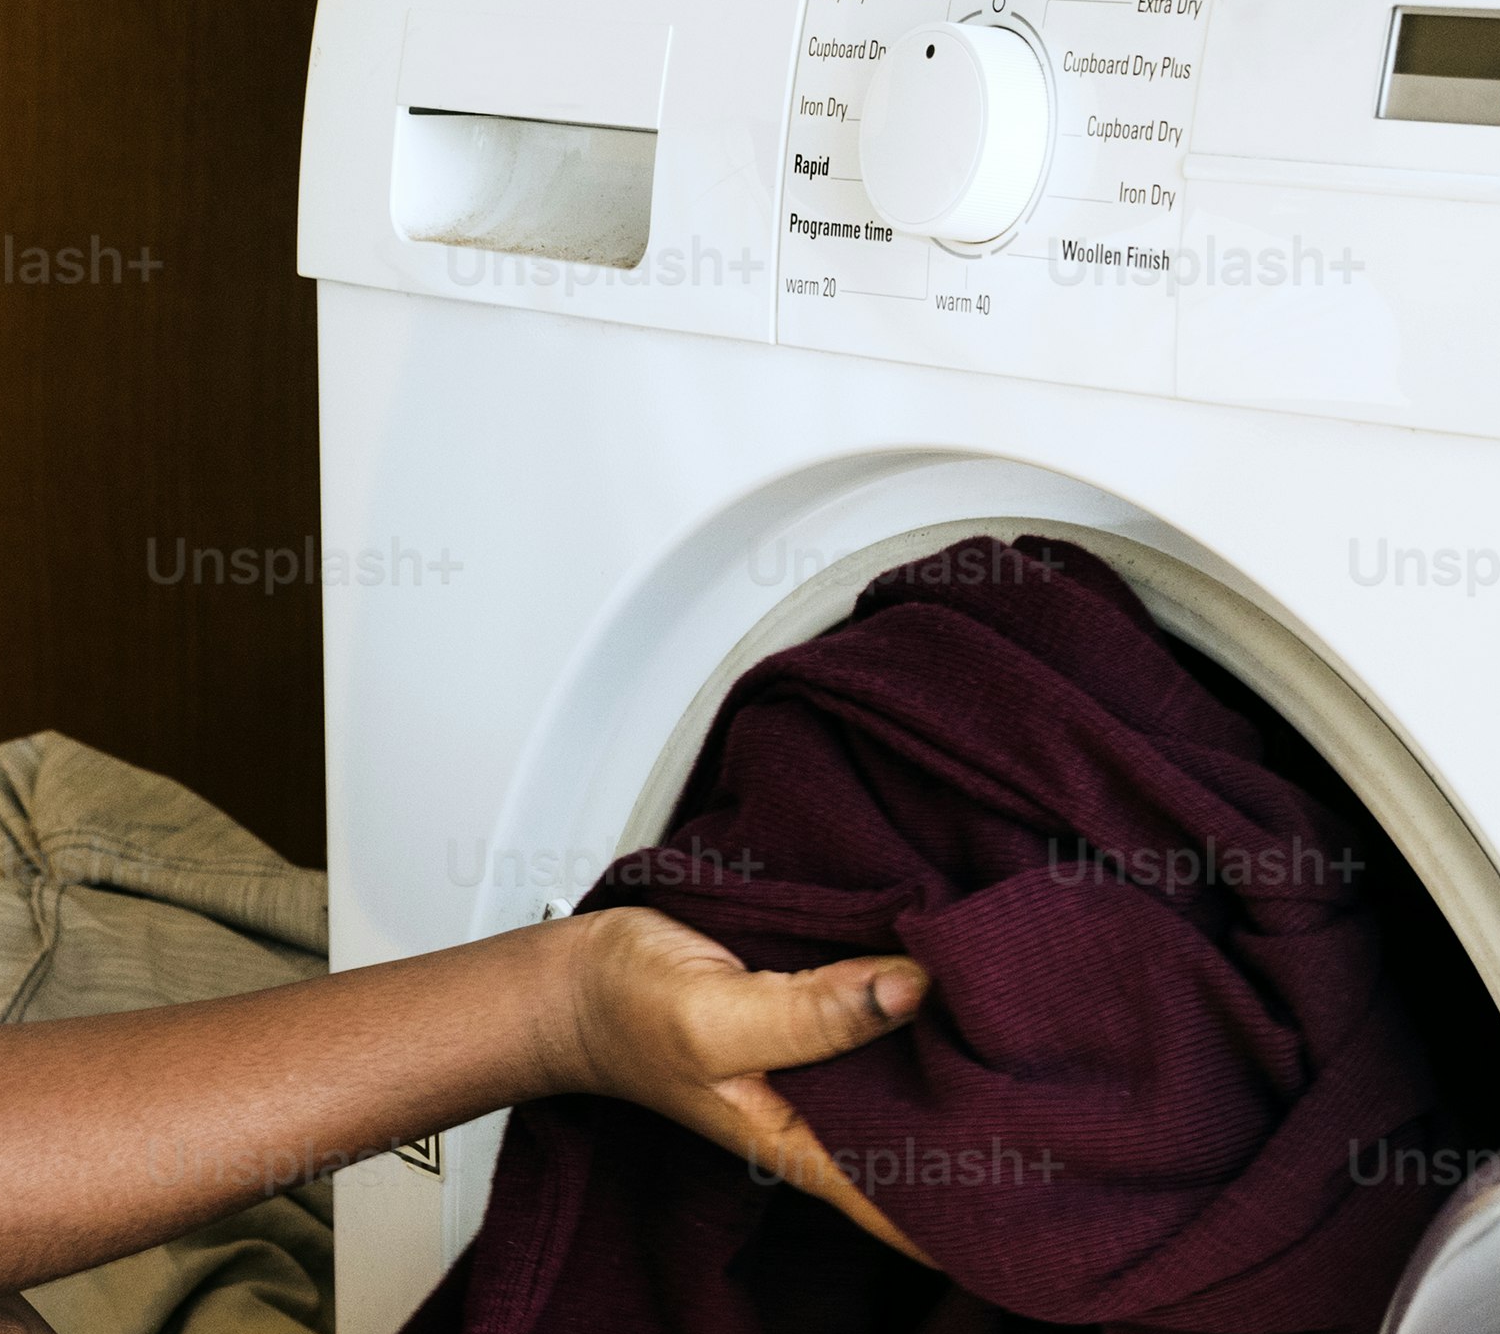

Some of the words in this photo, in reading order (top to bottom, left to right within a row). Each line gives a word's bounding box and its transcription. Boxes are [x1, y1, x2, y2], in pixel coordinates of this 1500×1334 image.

[808, 36, 865, 62] Cupboard
[869, 40, 890, 60] Dr
[1063, 50, 1130, 78] Cupboard
[1132, 55, 1158, 82] Dry
[1161, 56, 1191, 79] Plus
[799, 95, 823, 116] Iron
[827, 97, 848, 123] Dry
[1087, 115, 1154, 143] Cupboard
[1158, 120, 1183, 148] Dry
[794, 153, 830, 180] Rapid
[1119, 181, 1147, 204] Iron
[1151, 184, 1176, 212] Dry
[789, 213, 861, 240] Programme
[864, 220, 893, 243] time
[1062, 239, 1121, 266] Woollen
[1126, 246, 1170, 271] Finish
[785, 277, 819, 296] warm
[823, 277, 837, 298] 20
[935, 294, 972, 313] warm
[975, 294, 991, 315] 40
